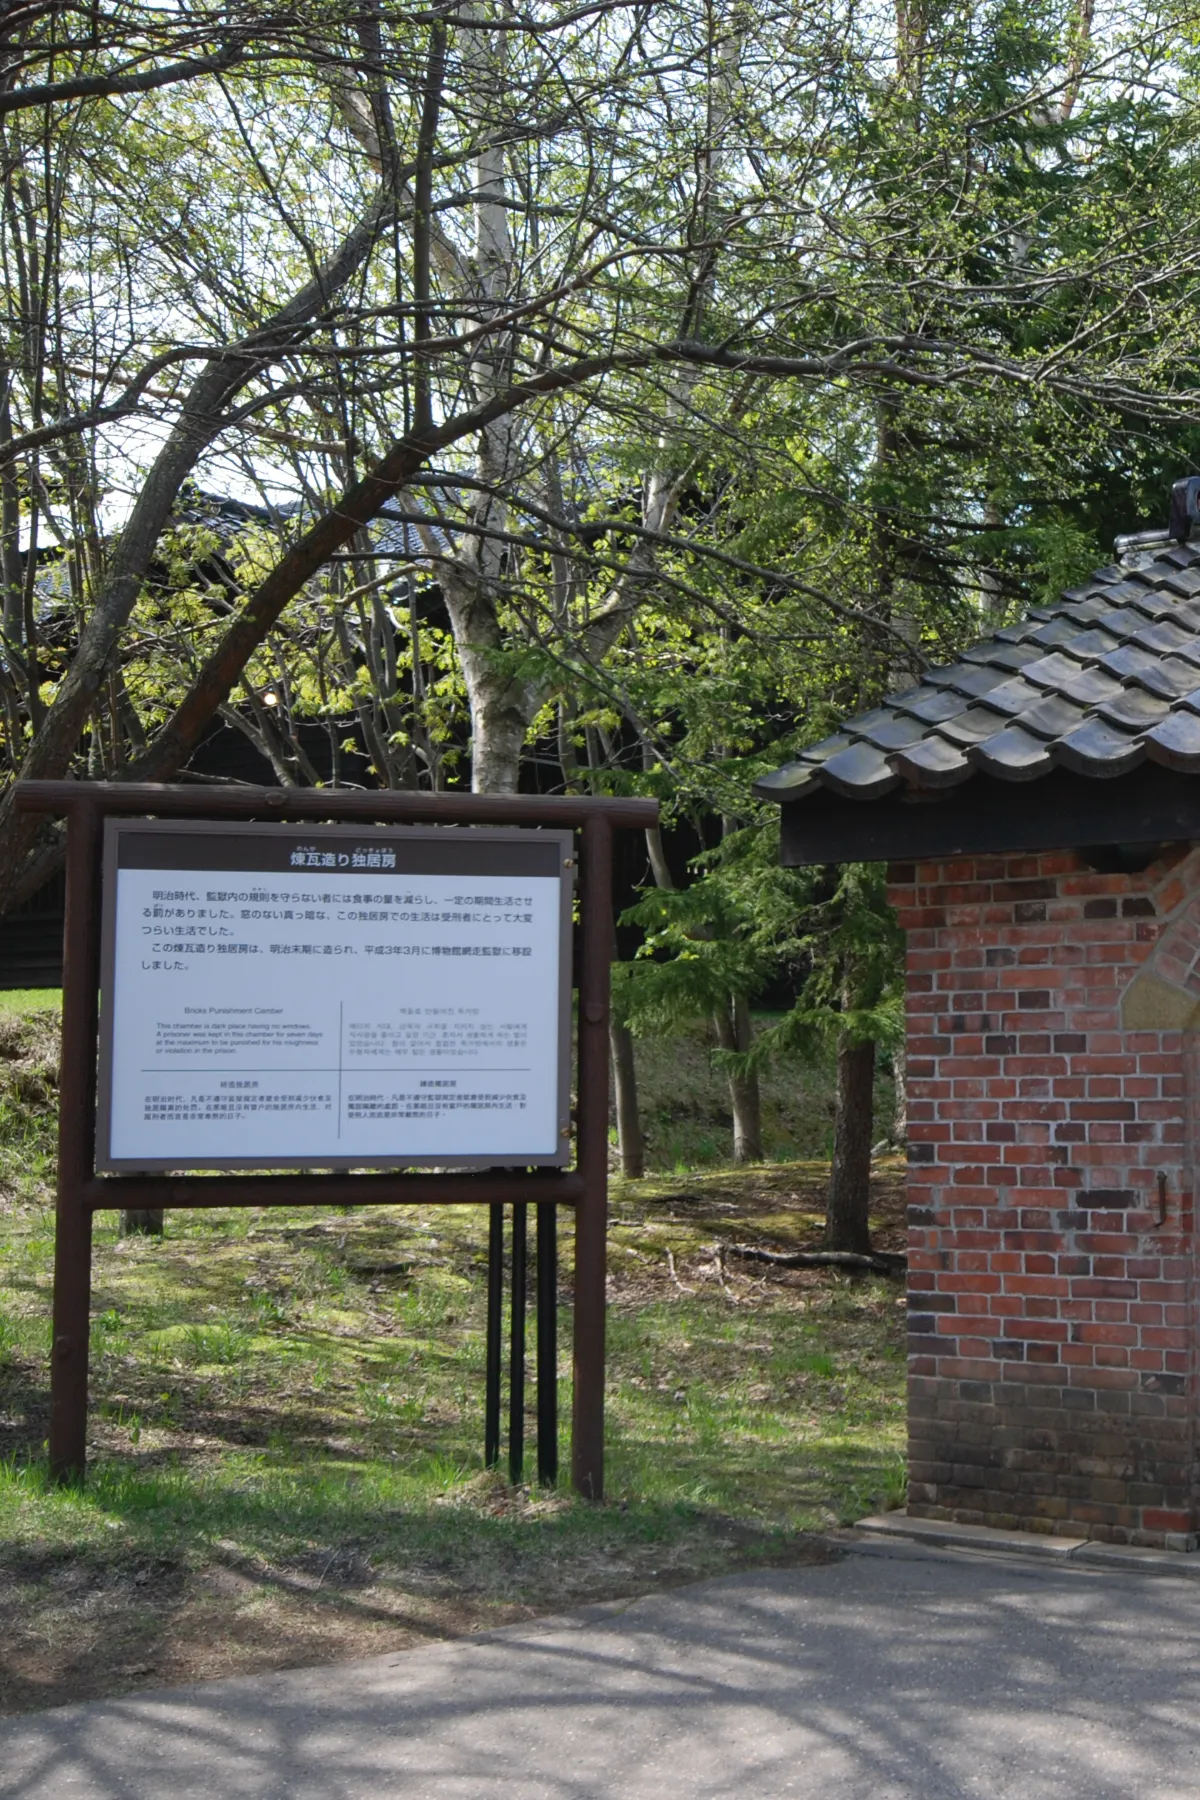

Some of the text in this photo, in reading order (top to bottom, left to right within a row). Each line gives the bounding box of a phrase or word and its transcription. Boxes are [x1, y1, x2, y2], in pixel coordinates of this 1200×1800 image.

[290, 852, 396, 868] 煉瓦造り独居房
[141, 926, 235, 936] つらい生活でした。
[141, 960, 189, 971] しました。
